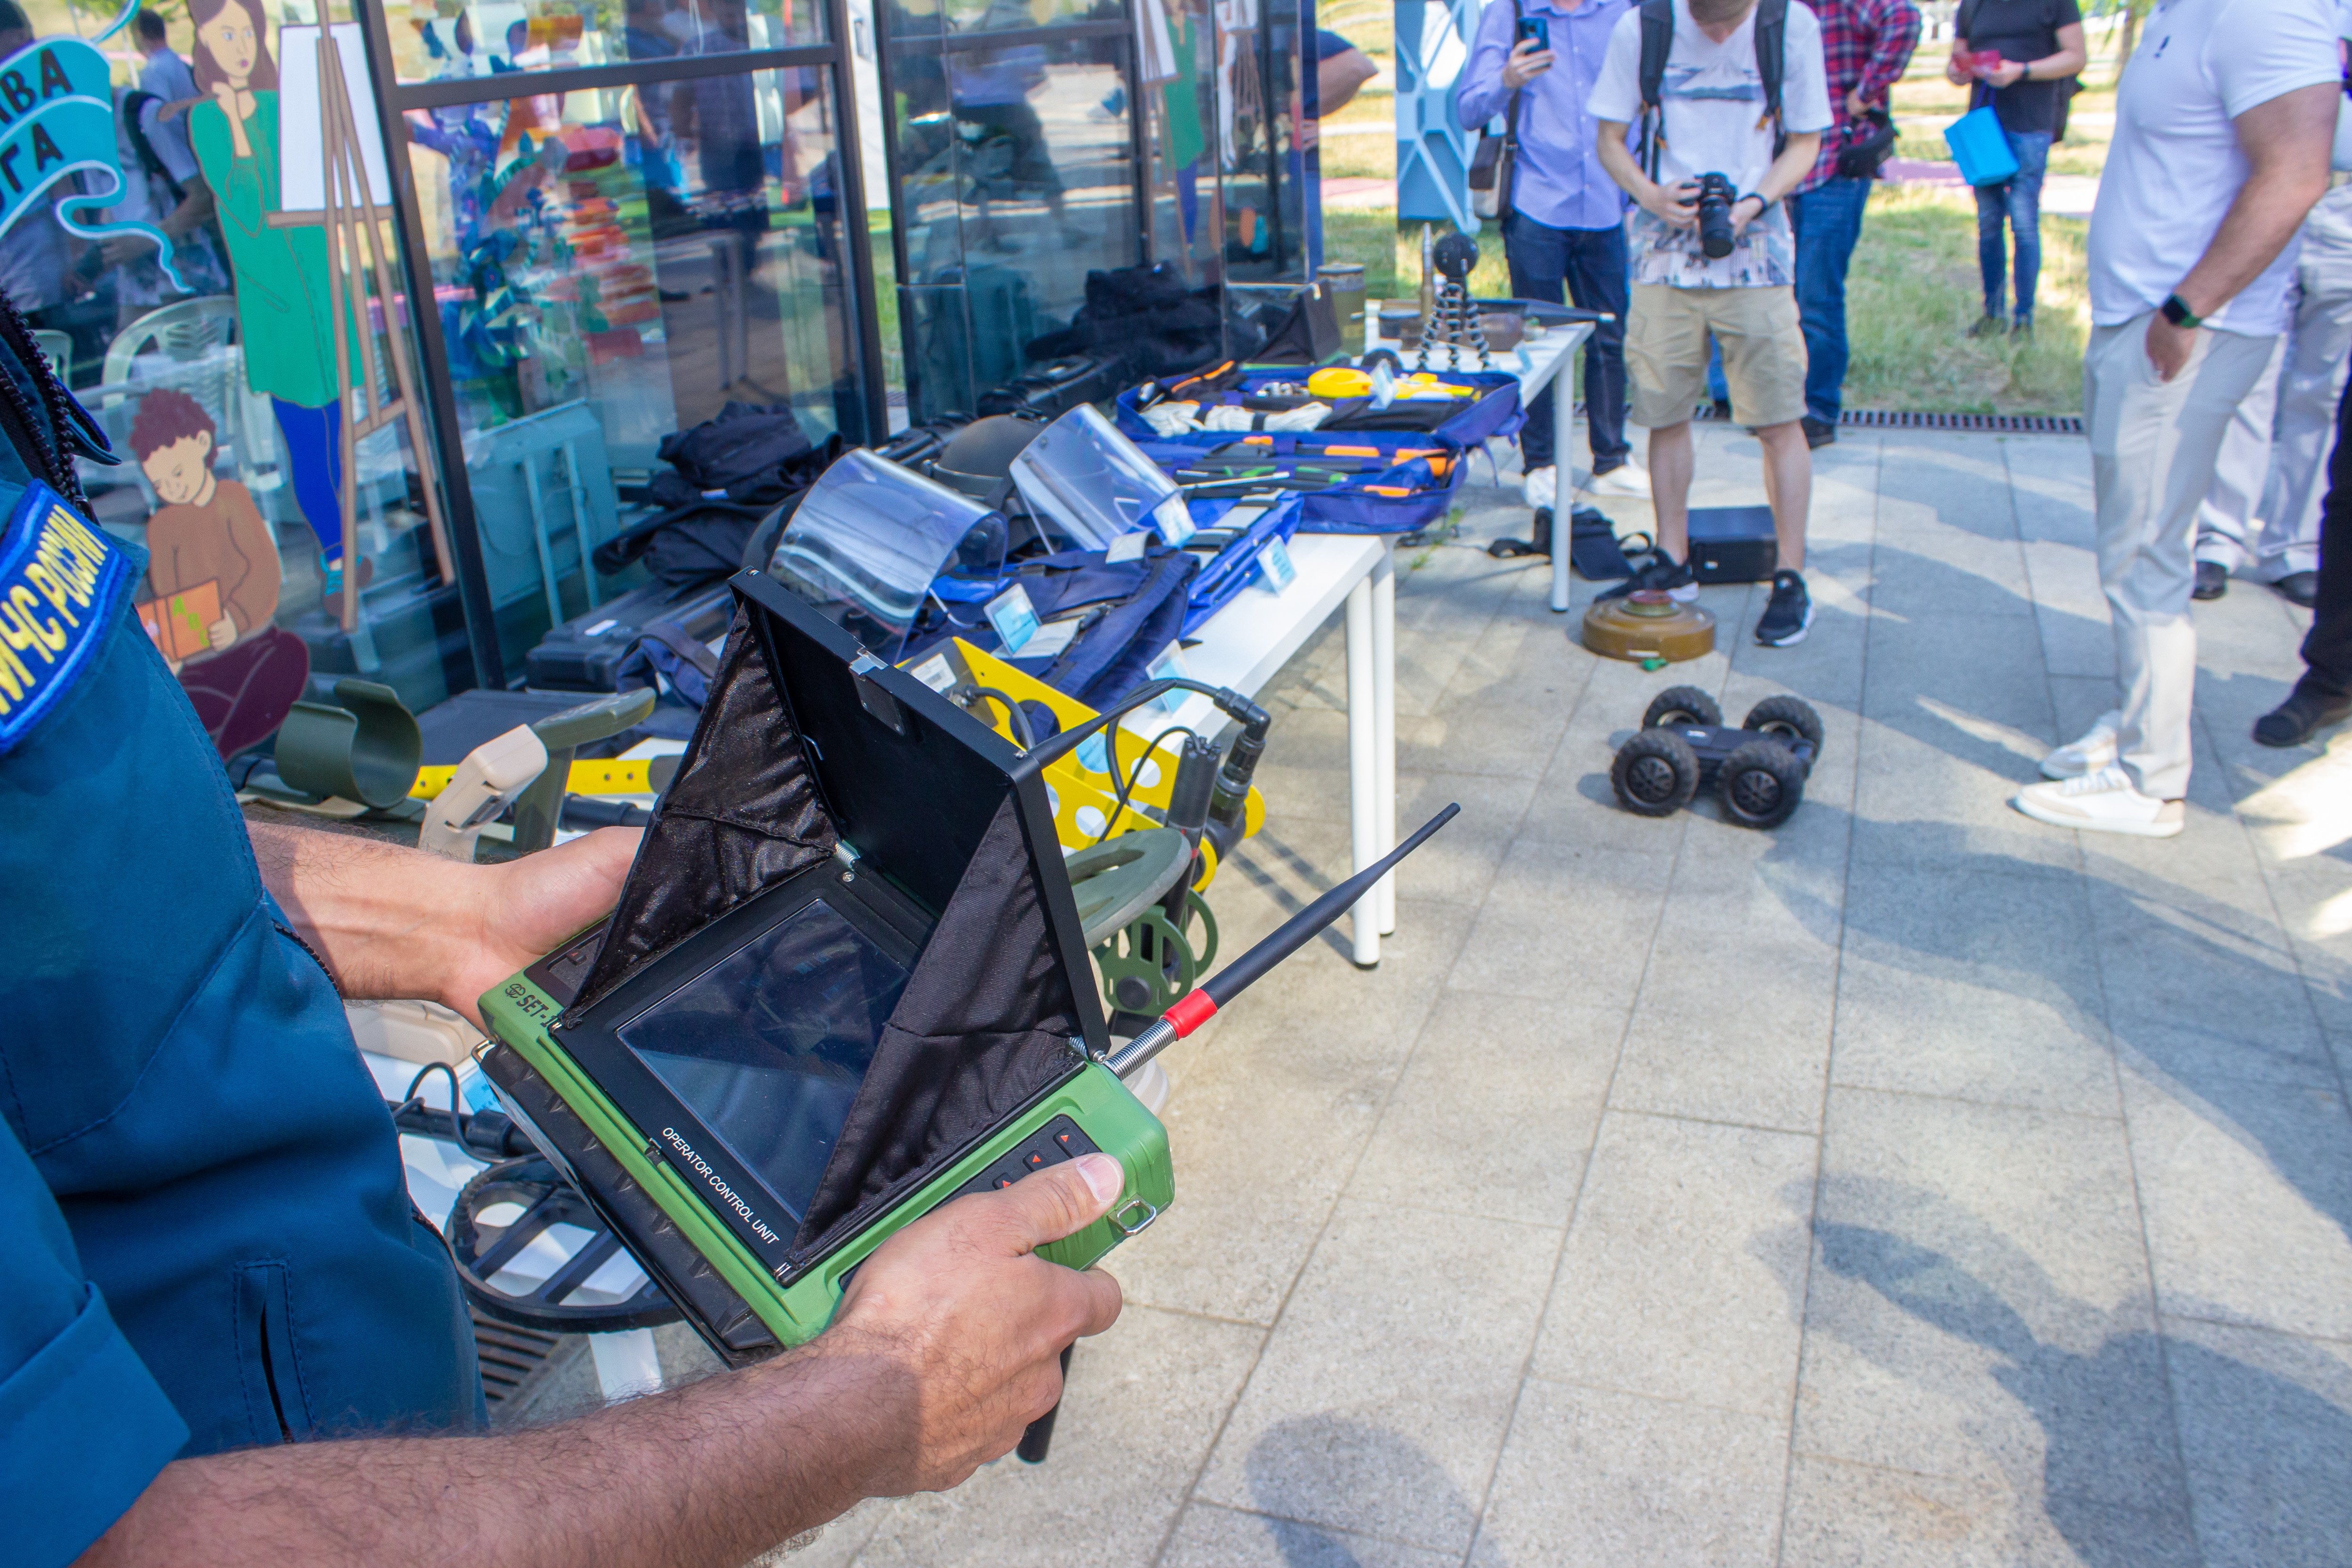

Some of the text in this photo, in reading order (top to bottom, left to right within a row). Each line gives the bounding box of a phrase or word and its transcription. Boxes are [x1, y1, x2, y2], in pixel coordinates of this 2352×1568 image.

[0, 122, 64, 211] ГА
[24, 503, 109, 628] РОССИИ
[662, 1127, 780, 1244] OPERATOR CONTROL UNIT
